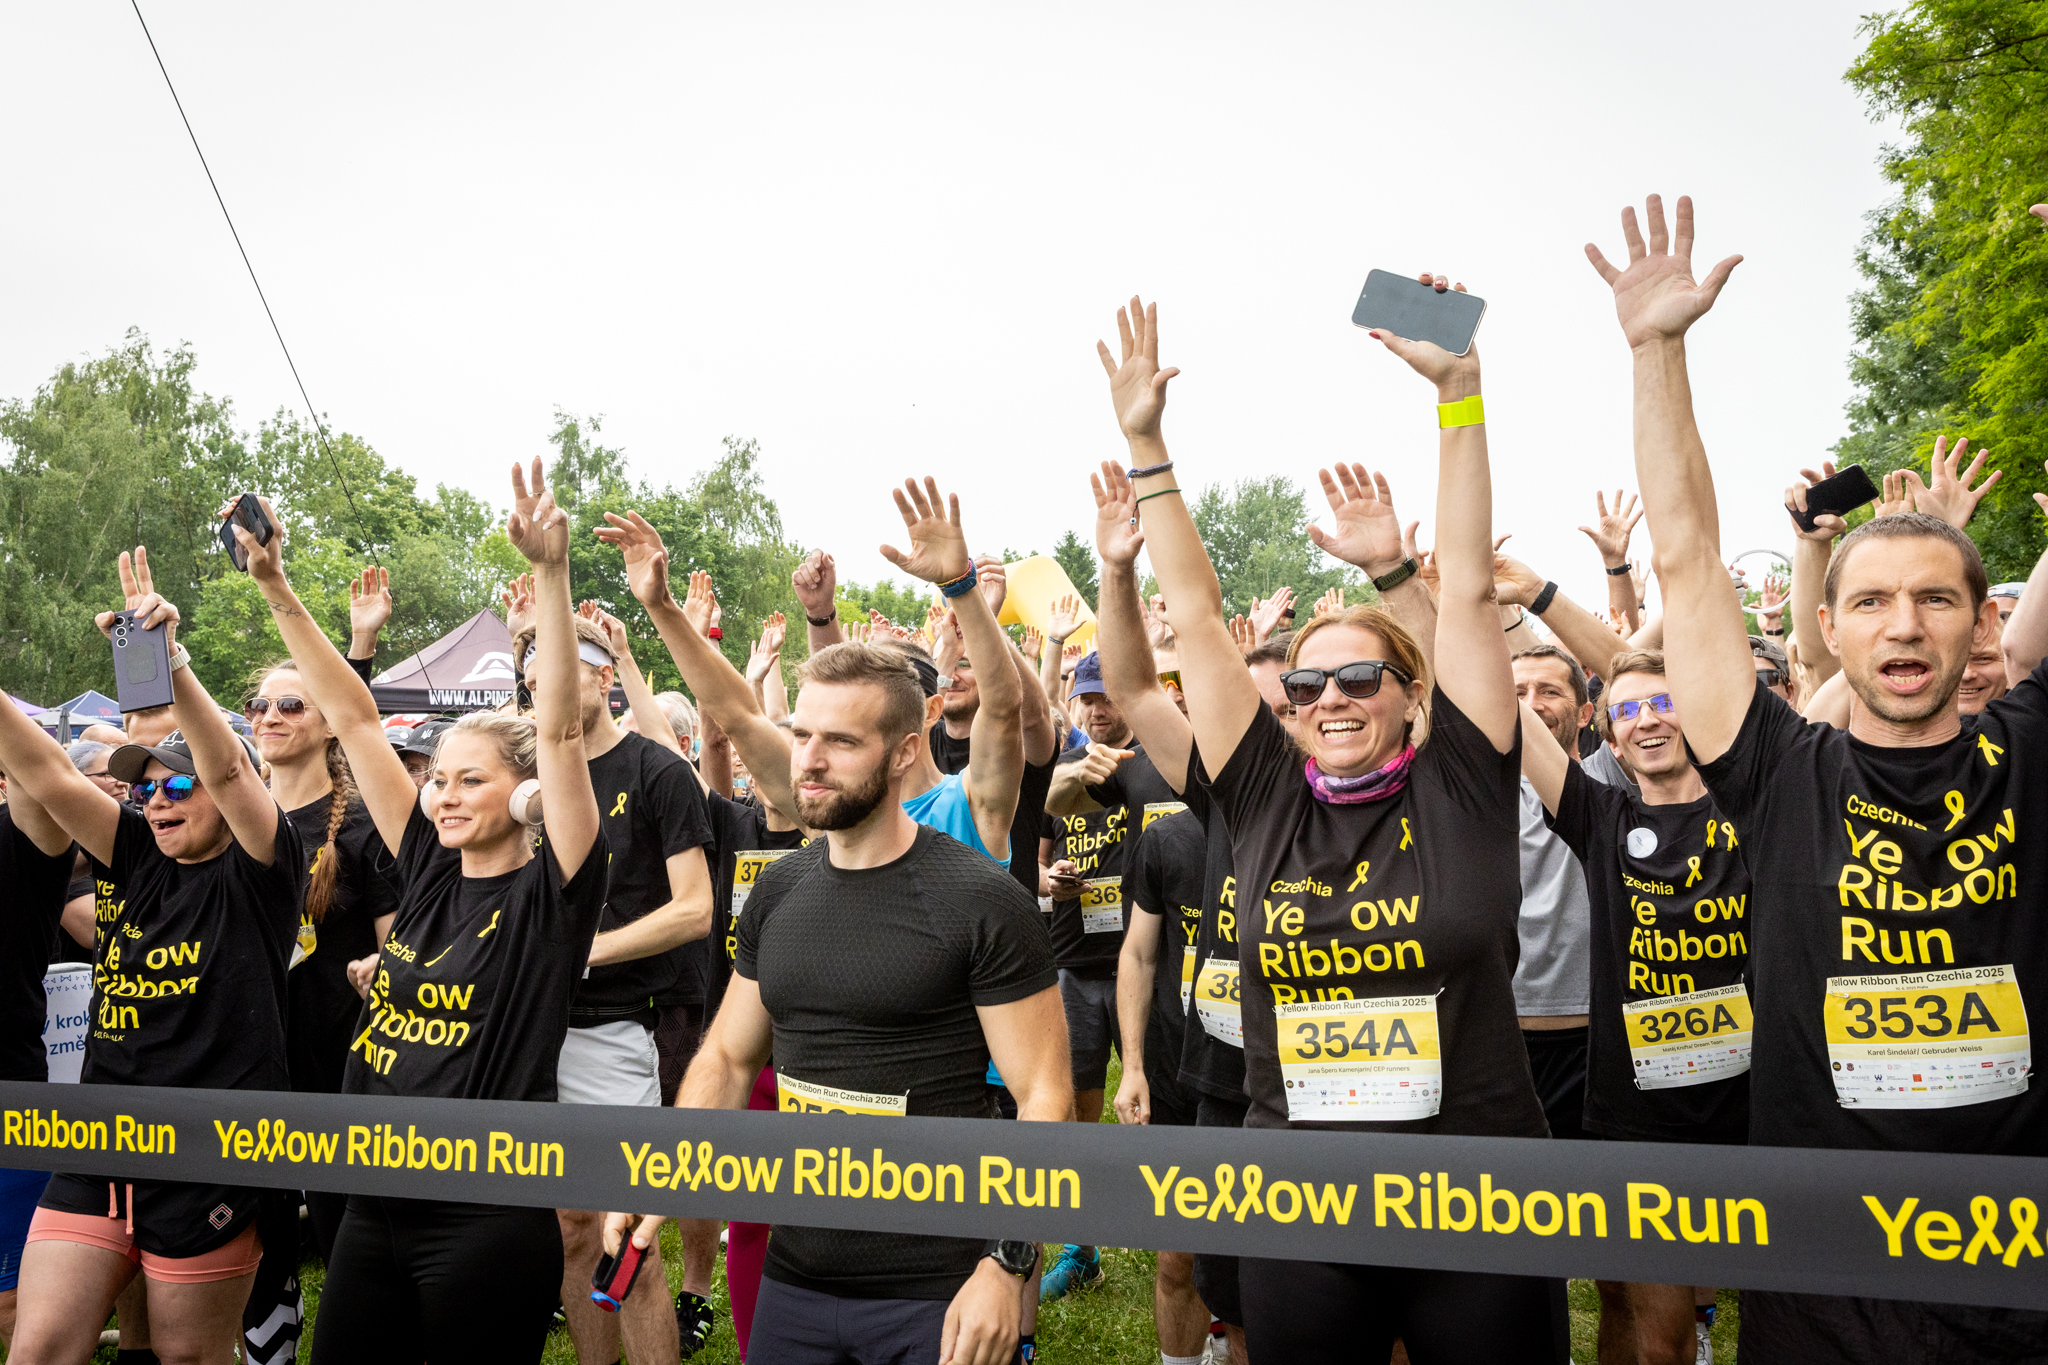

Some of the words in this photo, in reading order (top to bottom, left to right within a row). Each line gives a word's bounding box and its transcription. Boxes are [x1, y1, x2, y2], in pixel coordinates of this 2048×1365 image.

[428, 689, 517, 706] WWW.ALPINE
[1847, 794, 1927, 831] Czechia
[1066, 827, 1128, 855] Ribbon
[741, 861, 771, 882] 37
[1270, 876, 1333, 897] Czechia
[1838, 863, 2017, 912] Ribbon
[1263, 899, 1305, 936] Ye
[1350, 895, 1420, 931] ow
[1259, 938, 1425, 978] Ribbon
[1629, 926, 1748, 962] Ribbon
[1841, 916, 1955, 964] Run
[94, 963, 200, 998] Ribbon
[1629, 961, 1695, 996] Run
[1830, 978, 1858, 987] Yellow
[1860, 975, 1900, 986] Ribbon
[1901, 974, 1923, 985] Run
[1926, 969, 1973, 983] Czechia
[1974, 967, 2005, 978] 2025
[1281, 1003, 1309, 1013] Yellow
[1311, 1001, 1341, 1011] Ribbon
[1344, 999, 1361, 1010] Run
[1363, 998, 1400, 1009] Czechia
[1402, 998, 1427, 1006] 2025
[1628, 1002, 1648, 1010] Yellow
[1649, 998, 1674, 1007] Ribbon
[1674, 995, 1689, 1003] Run
[1690, 989, 1719, 1000] Czechia
[1720, 986, 1740, 995] 2025
[1844, 992, 2001, 1040] 353A
[1295, 1018, 1418, 1059] 354A
[1640, 1004, 1739, 1043] 326A
[1921, 1047, 1958, 1055] Gebruder
[1959, 1044, 1983, 1052] Weiss
[798, 1083, 822, 1094] Ribbon
[823, 1088, 838, 1098] Run
[840, 1091, 873, 1103] Czechia
[875, 1096, 899, 1105] 2025
[4, 1110, 108, 1150] Ribbon
[115, 1115, 176, 1154] Run
[214, 1118, 339, 1164] Yellow
[347, 1124, 477, 1172] Ribbon
[487, 1131, 564, 1177] Run
[620, 1140, 782, 1193] Yellow
[794, 1147, 965, 1202] Ribbon
[980, 1155, 1081, 1209] Run
[1139, 1163, 1357, 1225] Yellow
[1374, 1171, 1607, 1238] Ribbon
[1626, 1182, 1769, 1246] Run
[1862, 1195, 2048, 1268] Yell
